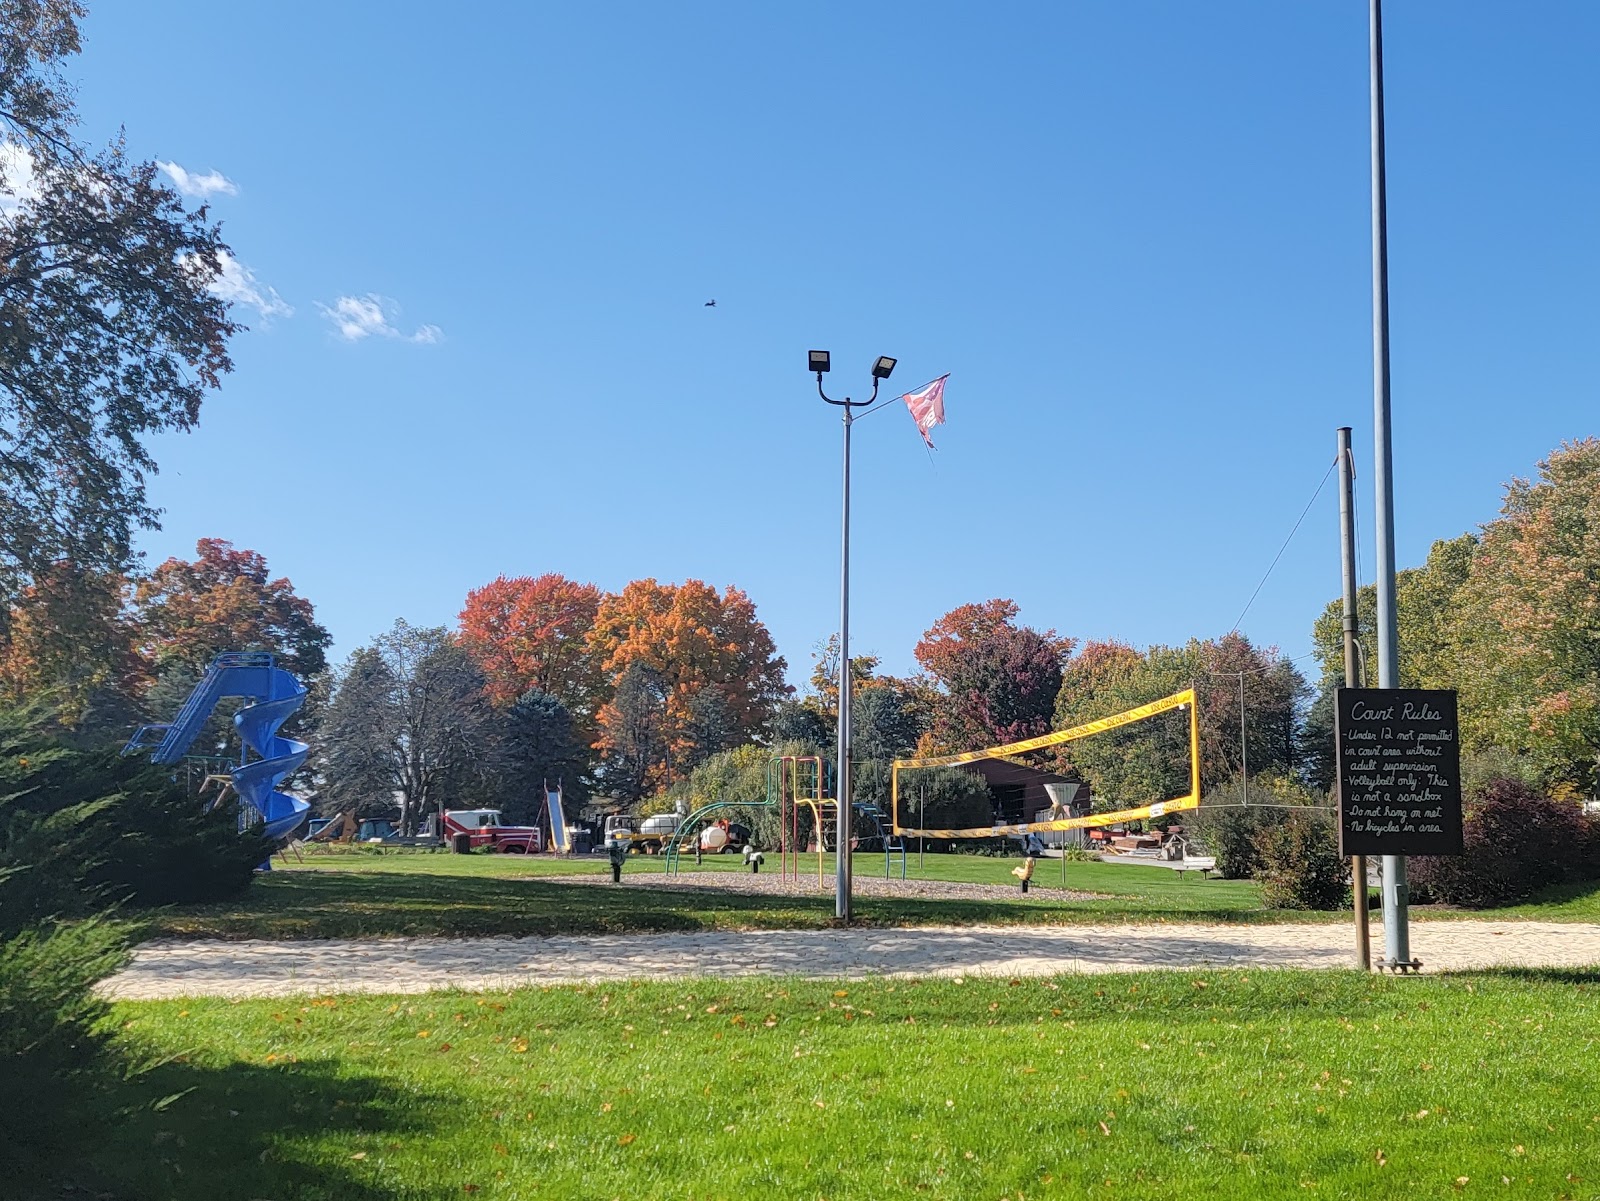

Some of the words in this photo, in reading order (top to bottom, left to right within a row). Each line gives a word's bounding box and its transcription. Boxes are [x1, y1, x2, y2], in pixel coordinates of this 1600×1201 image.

[1351, 701, 1395, 720] Court
[1401, 702, 1442, 720] Rules
[1380, 727, 1394, 740] 12
[1396, 729, 1415, 740] not
[1417, 729, 1453, 746] permitted
[1344, 745, 1356, 756] in
[1358, 745, 1382, 756] court
[1406, 744, 1443, 756] without
[1350, 759, 1377, 771] adult
[1383, 762, 1437, 776] supervision
[1397, 773, 1421, 791] only:
[1427, 774, 1449, 787] This
[1351, 791, 1360, 802] is
[1363, 790, 1381, 802] not
[1384, 793, 1392, 802] a
[1397, 788, 1442, 802] sandbox
[1364, 807, 1382, 817] not
[1383, 806, 1407, 824] hang
[1410, 809, 1421, 818] on
[1424, 806, 1442, 817] net
[1365, 819, 1400, 836] bicycles
[1402, 822, 1415, 832] in
[1419, 823, 1443, 832] area
